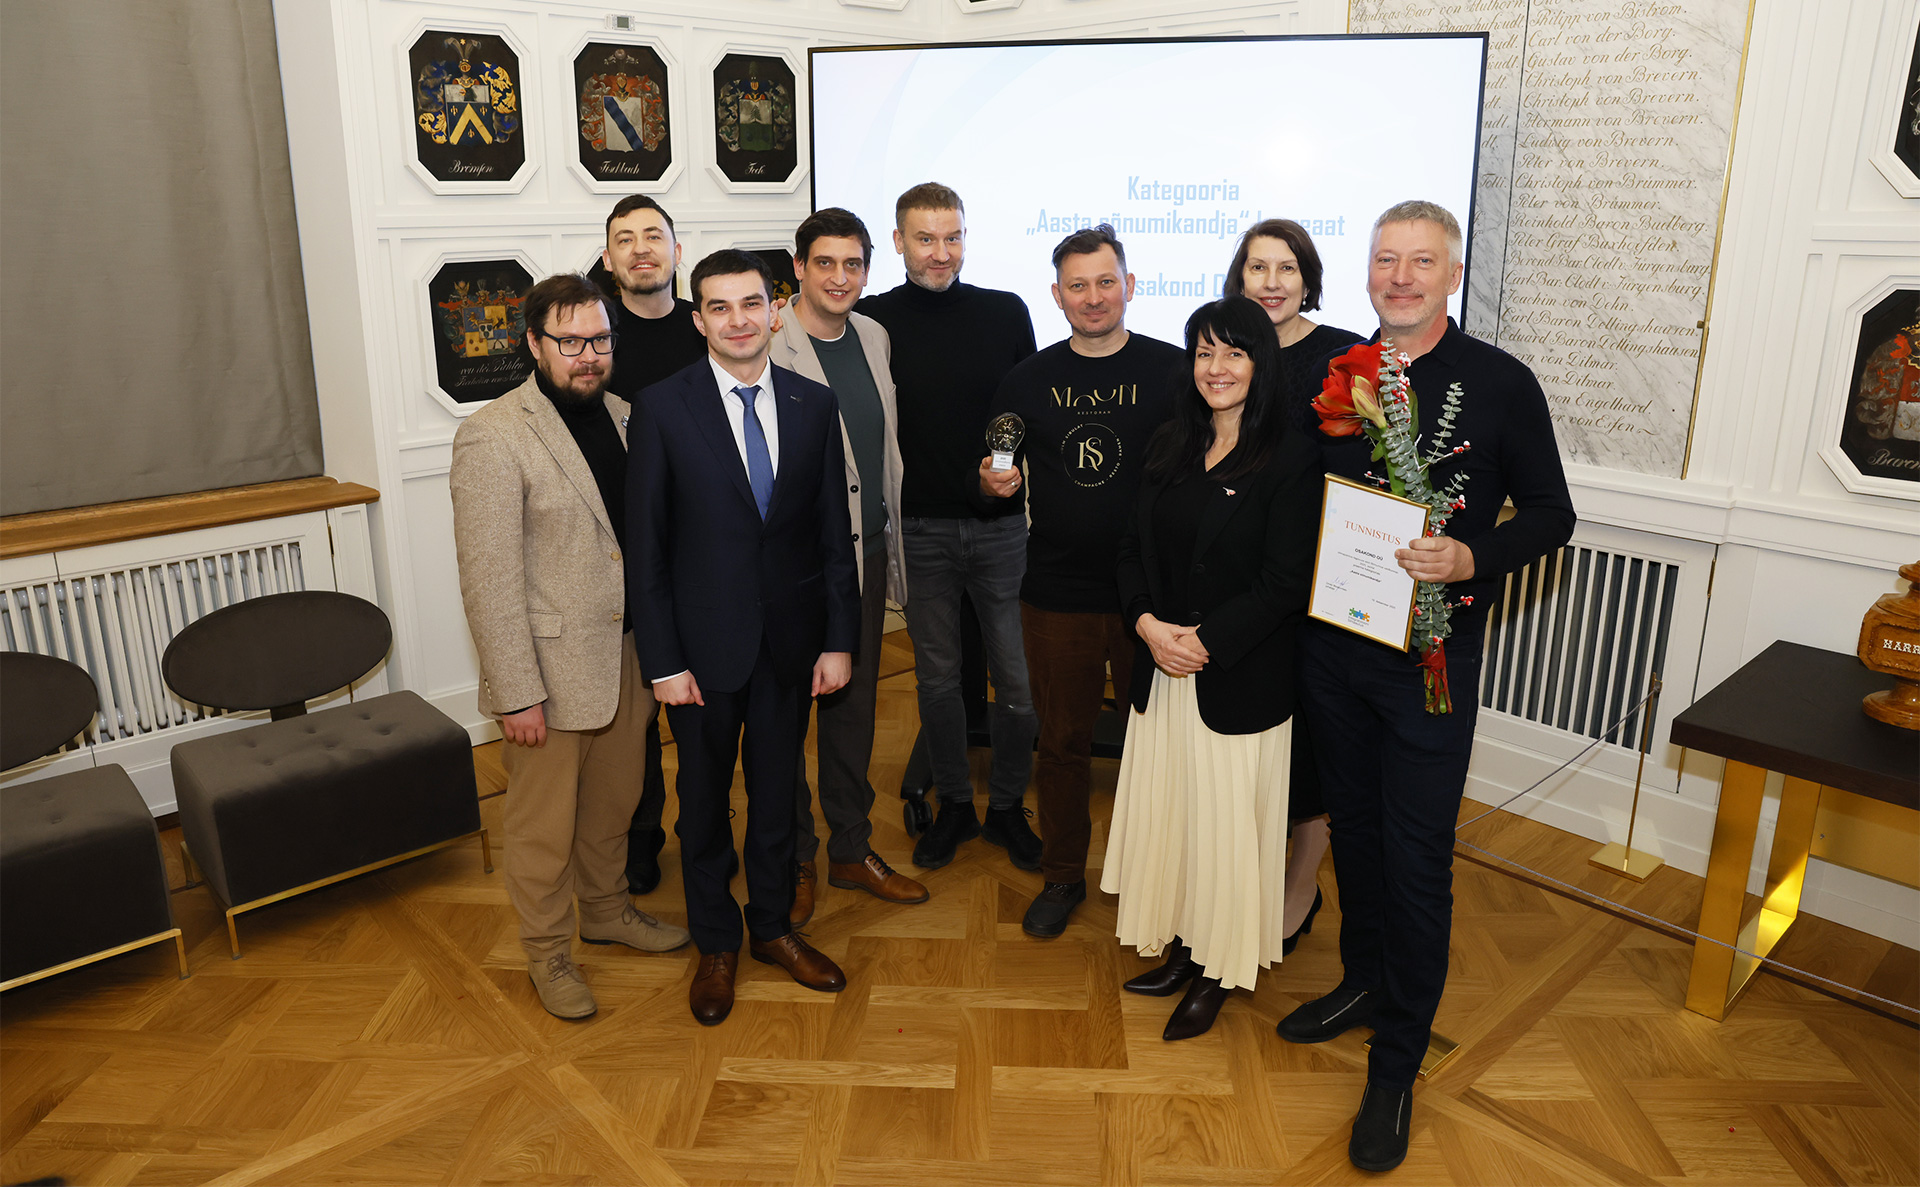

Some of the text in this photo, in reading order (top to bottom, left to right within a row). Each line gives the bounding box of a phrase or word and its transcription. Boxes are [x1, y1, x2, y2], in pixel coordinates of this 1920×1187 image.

[1439, 5, 1461, 15] von
[1530, 9, 1581, 29] Philipp
[1587, 12, 1610, 22] von
[1529, 30, 1562, 47] Carl
[1565, 33, 1590, 45] von
[1595, 26, 1622, 43] der
[1624, 21, 1675, 43] Borg.
[1525, 51, 1576, 73] Gustav
[1583, 54, 1609, 65] von
[1614, 47, 1640, 62] der
[1642, 43, 1692, 66] Borg.
[1525, 69, 1592, 90] Christoph
[1597, 74, 1623, 85] von
[1625, 65, 1702, 83] Brevern.
[1523, 87, 1699, 110] Christoph von Brevern.
[1520, 111, 1591, 128] Hermann
[1596, 117, 1622, 127] von
[1625, 109, 1703, 125] Brevern.
[1518, 133, 1571, 150] Ludwig
[1577, 138, 1602, 148] von
[1604, 130, 1679, 147] Brevern.
[1516, 151, 1665, 168] Peter von Brevern.
[1127, 176, 1240, 206] Kategooria
[1515, 172, 1582, 193] Christoph
[1588, 179, 1615, 189] von
[1513, 193, 1548, 209] Peter
[1554, 199, 1579, 209] von
[1510, 213, 1578, 229] Reinhold
[1578, 214, 1630, 231] Baron
[1508, 232, 1543, 248] Peter
[1544, 232, 1586, 253] Graf
[1134, 272, 1205, 297] sakond
[1504, 270, 1535, 286] Carl
[1502, 289, 1634, 312] Joachim von Dehn.
[1501, 307, 1535, 324] Carl
[1533, 310, 1582, 328] Baron
[1499, 325, 1551, 344] Eduard
[1550, 331, 1596, 350] Baron
[1541, 355, 1564, 366] von
[1548, 394, 1572, 405] von
[1569, 415, 1593, 427] von
[1345, 519, 1401, 546] TUNNISTUS
